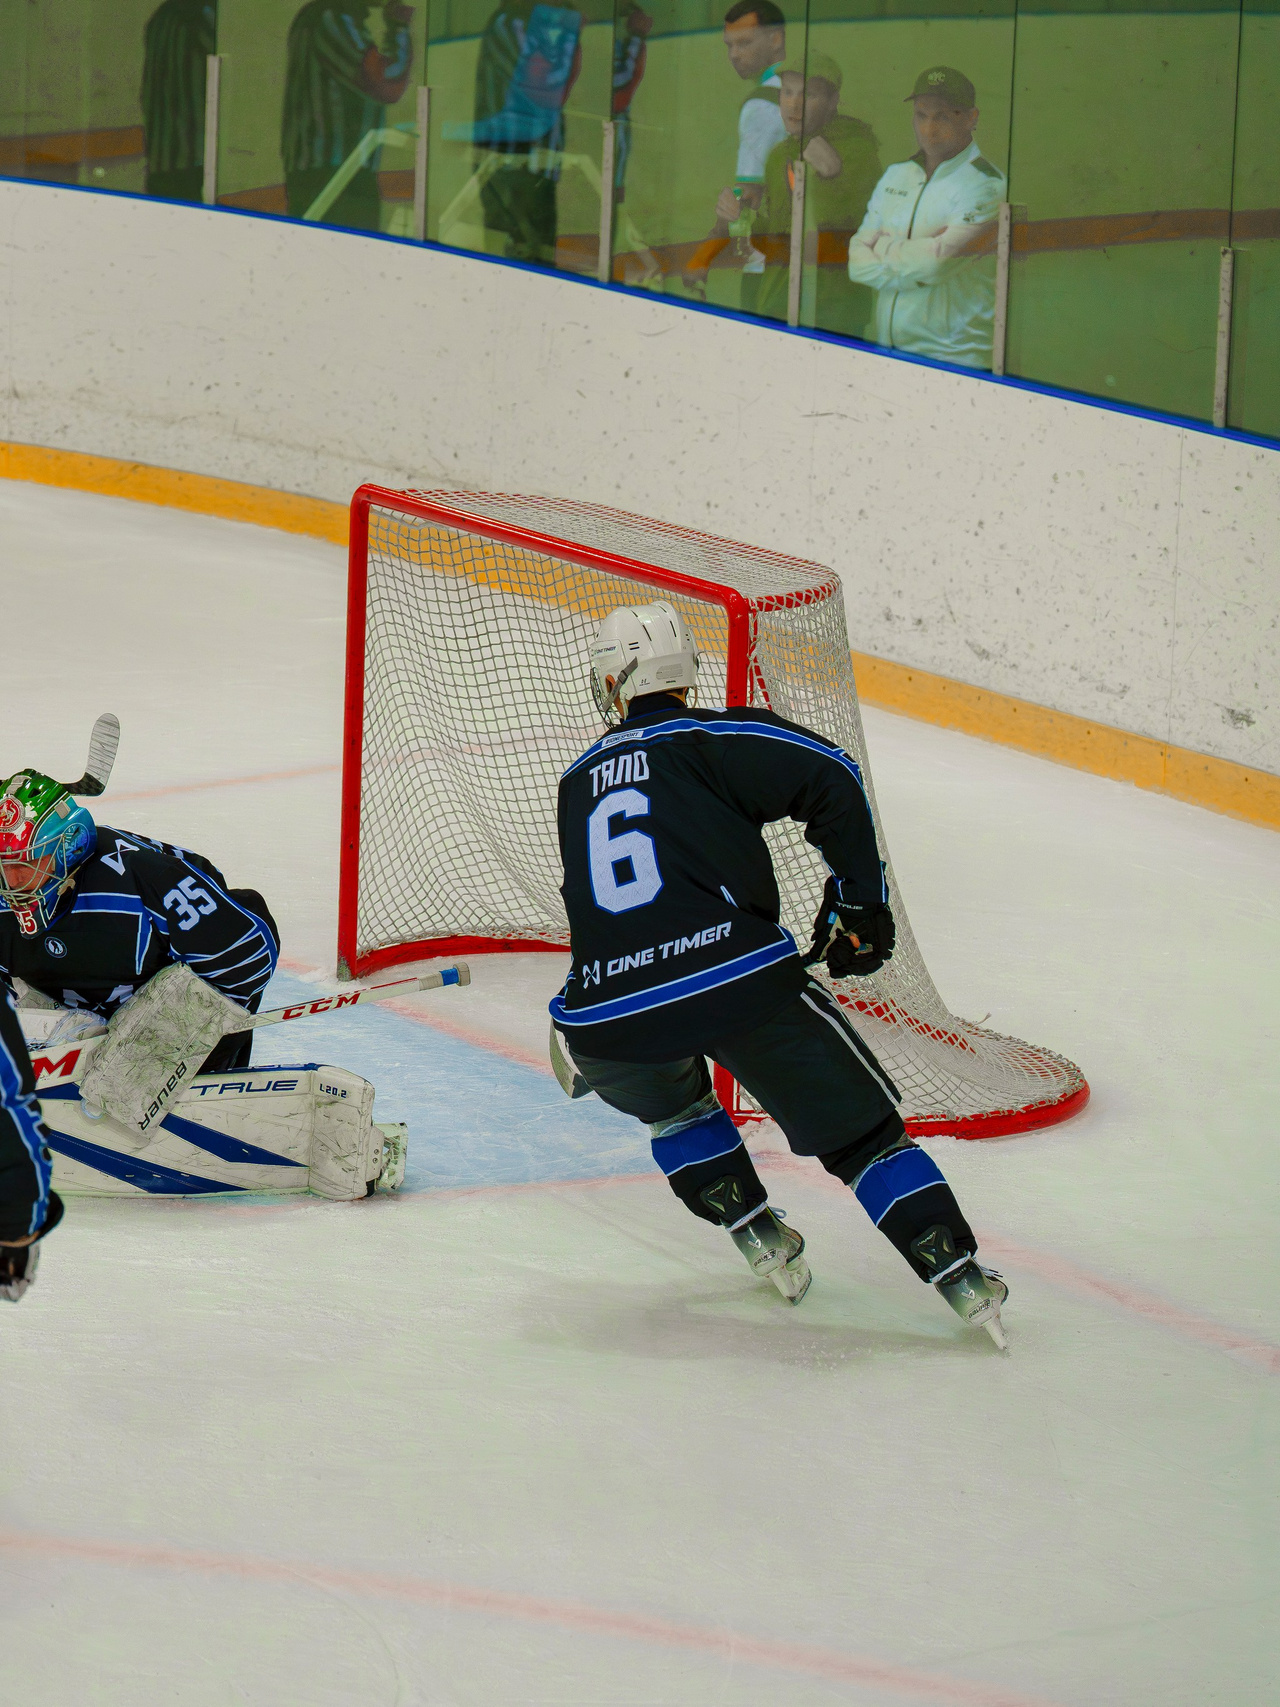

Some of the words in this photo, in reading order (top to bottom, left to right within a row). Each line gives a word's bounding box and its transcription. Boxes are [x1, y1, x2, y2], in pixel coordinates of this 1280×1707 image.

[586, 786, 665, 916] 6
[163, 875, 218, 931] 35
[606, 947, 655, 977] ONE
[658, 921, 732, 960] TIMER
[281, 992, 362, 1021] CCM
[189, 1079, 299, 1096] TRUE
